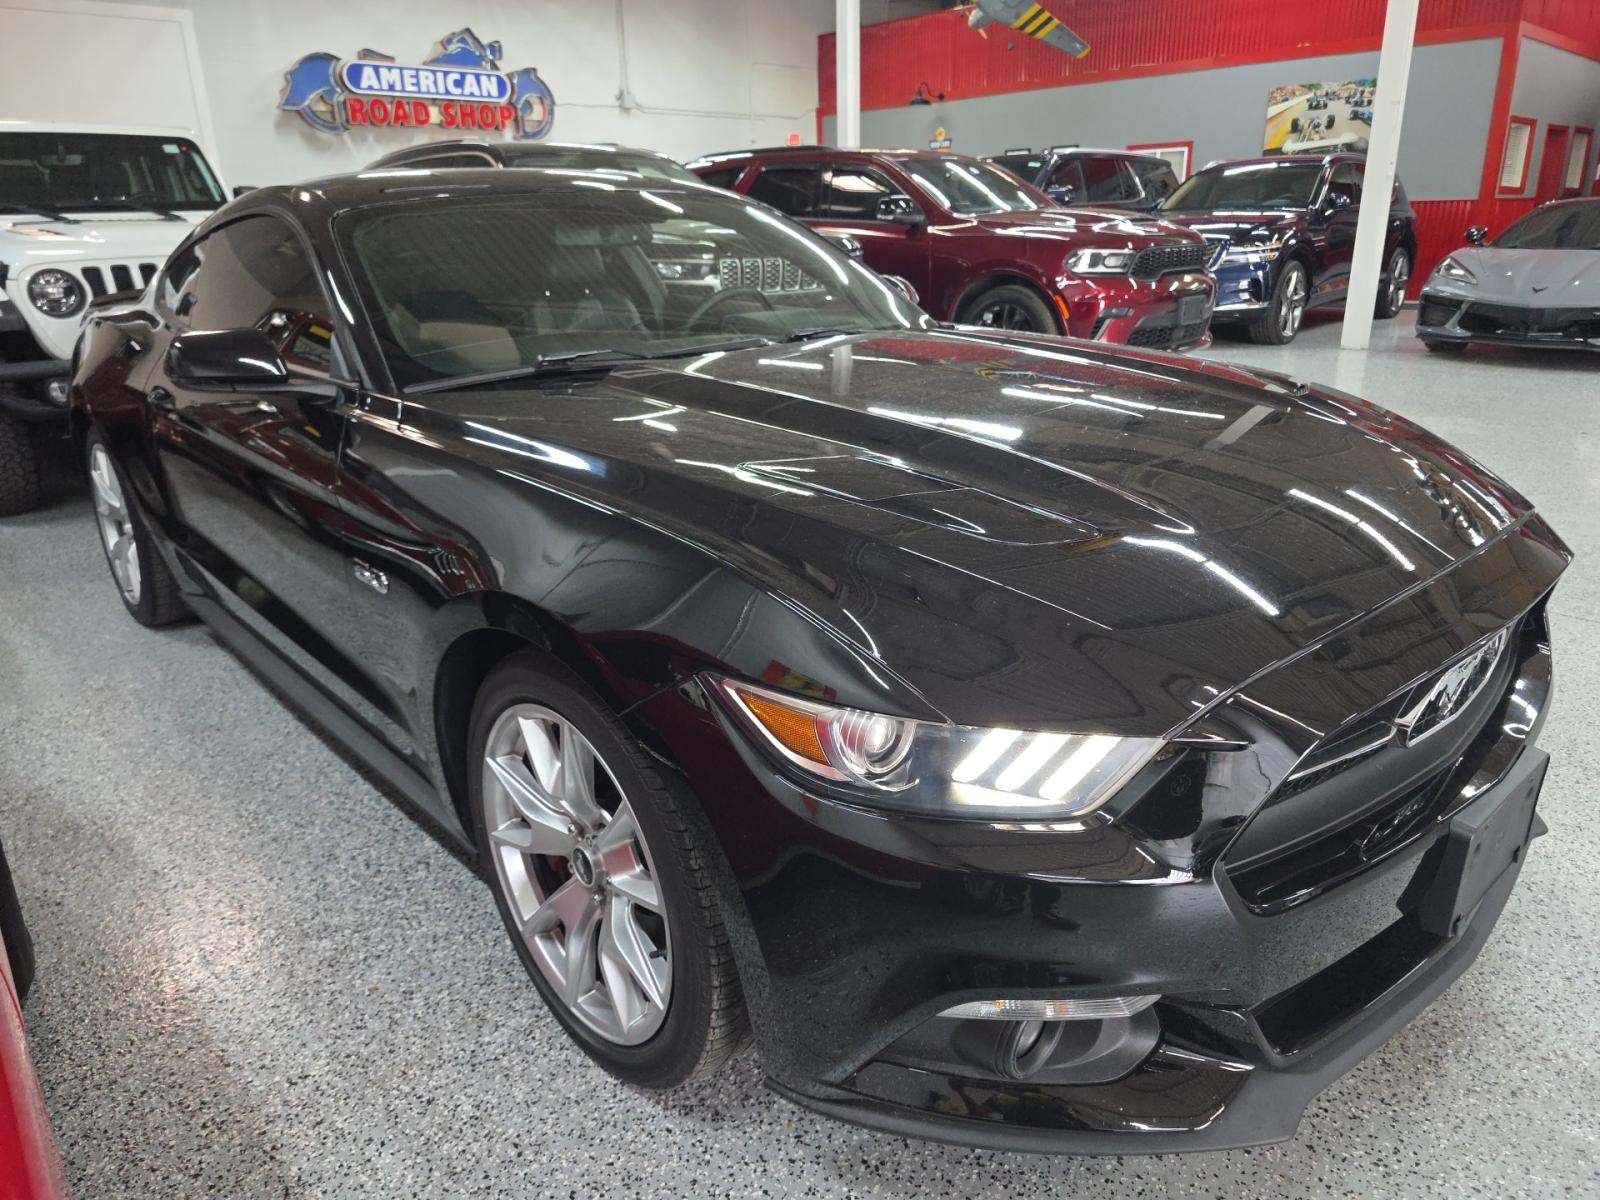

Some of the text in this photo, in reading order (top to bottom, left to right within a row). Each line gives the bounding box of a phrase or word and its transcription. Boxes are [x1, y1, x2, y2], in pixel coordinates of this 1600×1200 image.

[360, 65, 499, 98] AMERICAN
[348, 98, 515, 130] ROAD SHOP
